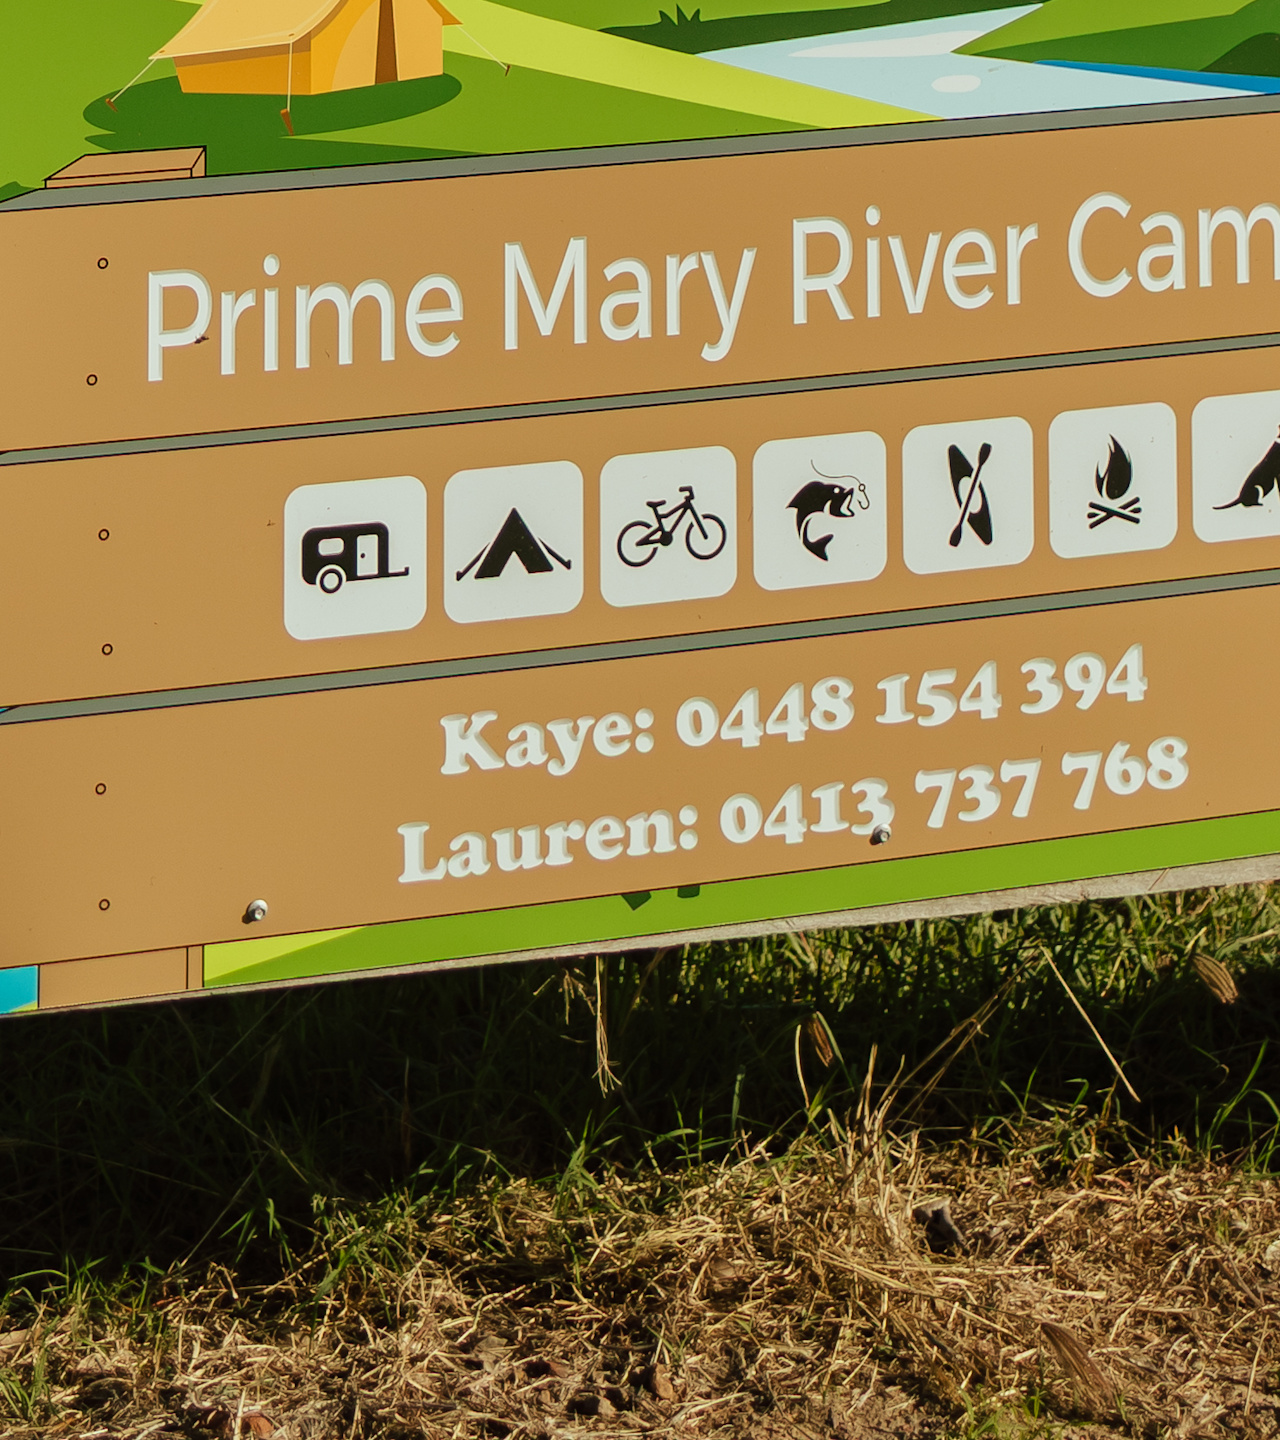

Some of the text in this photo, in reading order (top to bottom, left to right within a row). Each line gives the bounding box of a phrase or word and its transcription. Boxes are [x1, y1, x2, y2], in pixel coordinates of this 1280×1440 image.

[146, 253, 465, 383] Prime
[503, 236, 758, 363] Mary
[791, 204, 1040, 326] River
[438, 643, 1149, 778] Kaye: 0448 154 394
[396, 735, 1190, 885] Lauren: 0413 737 768
